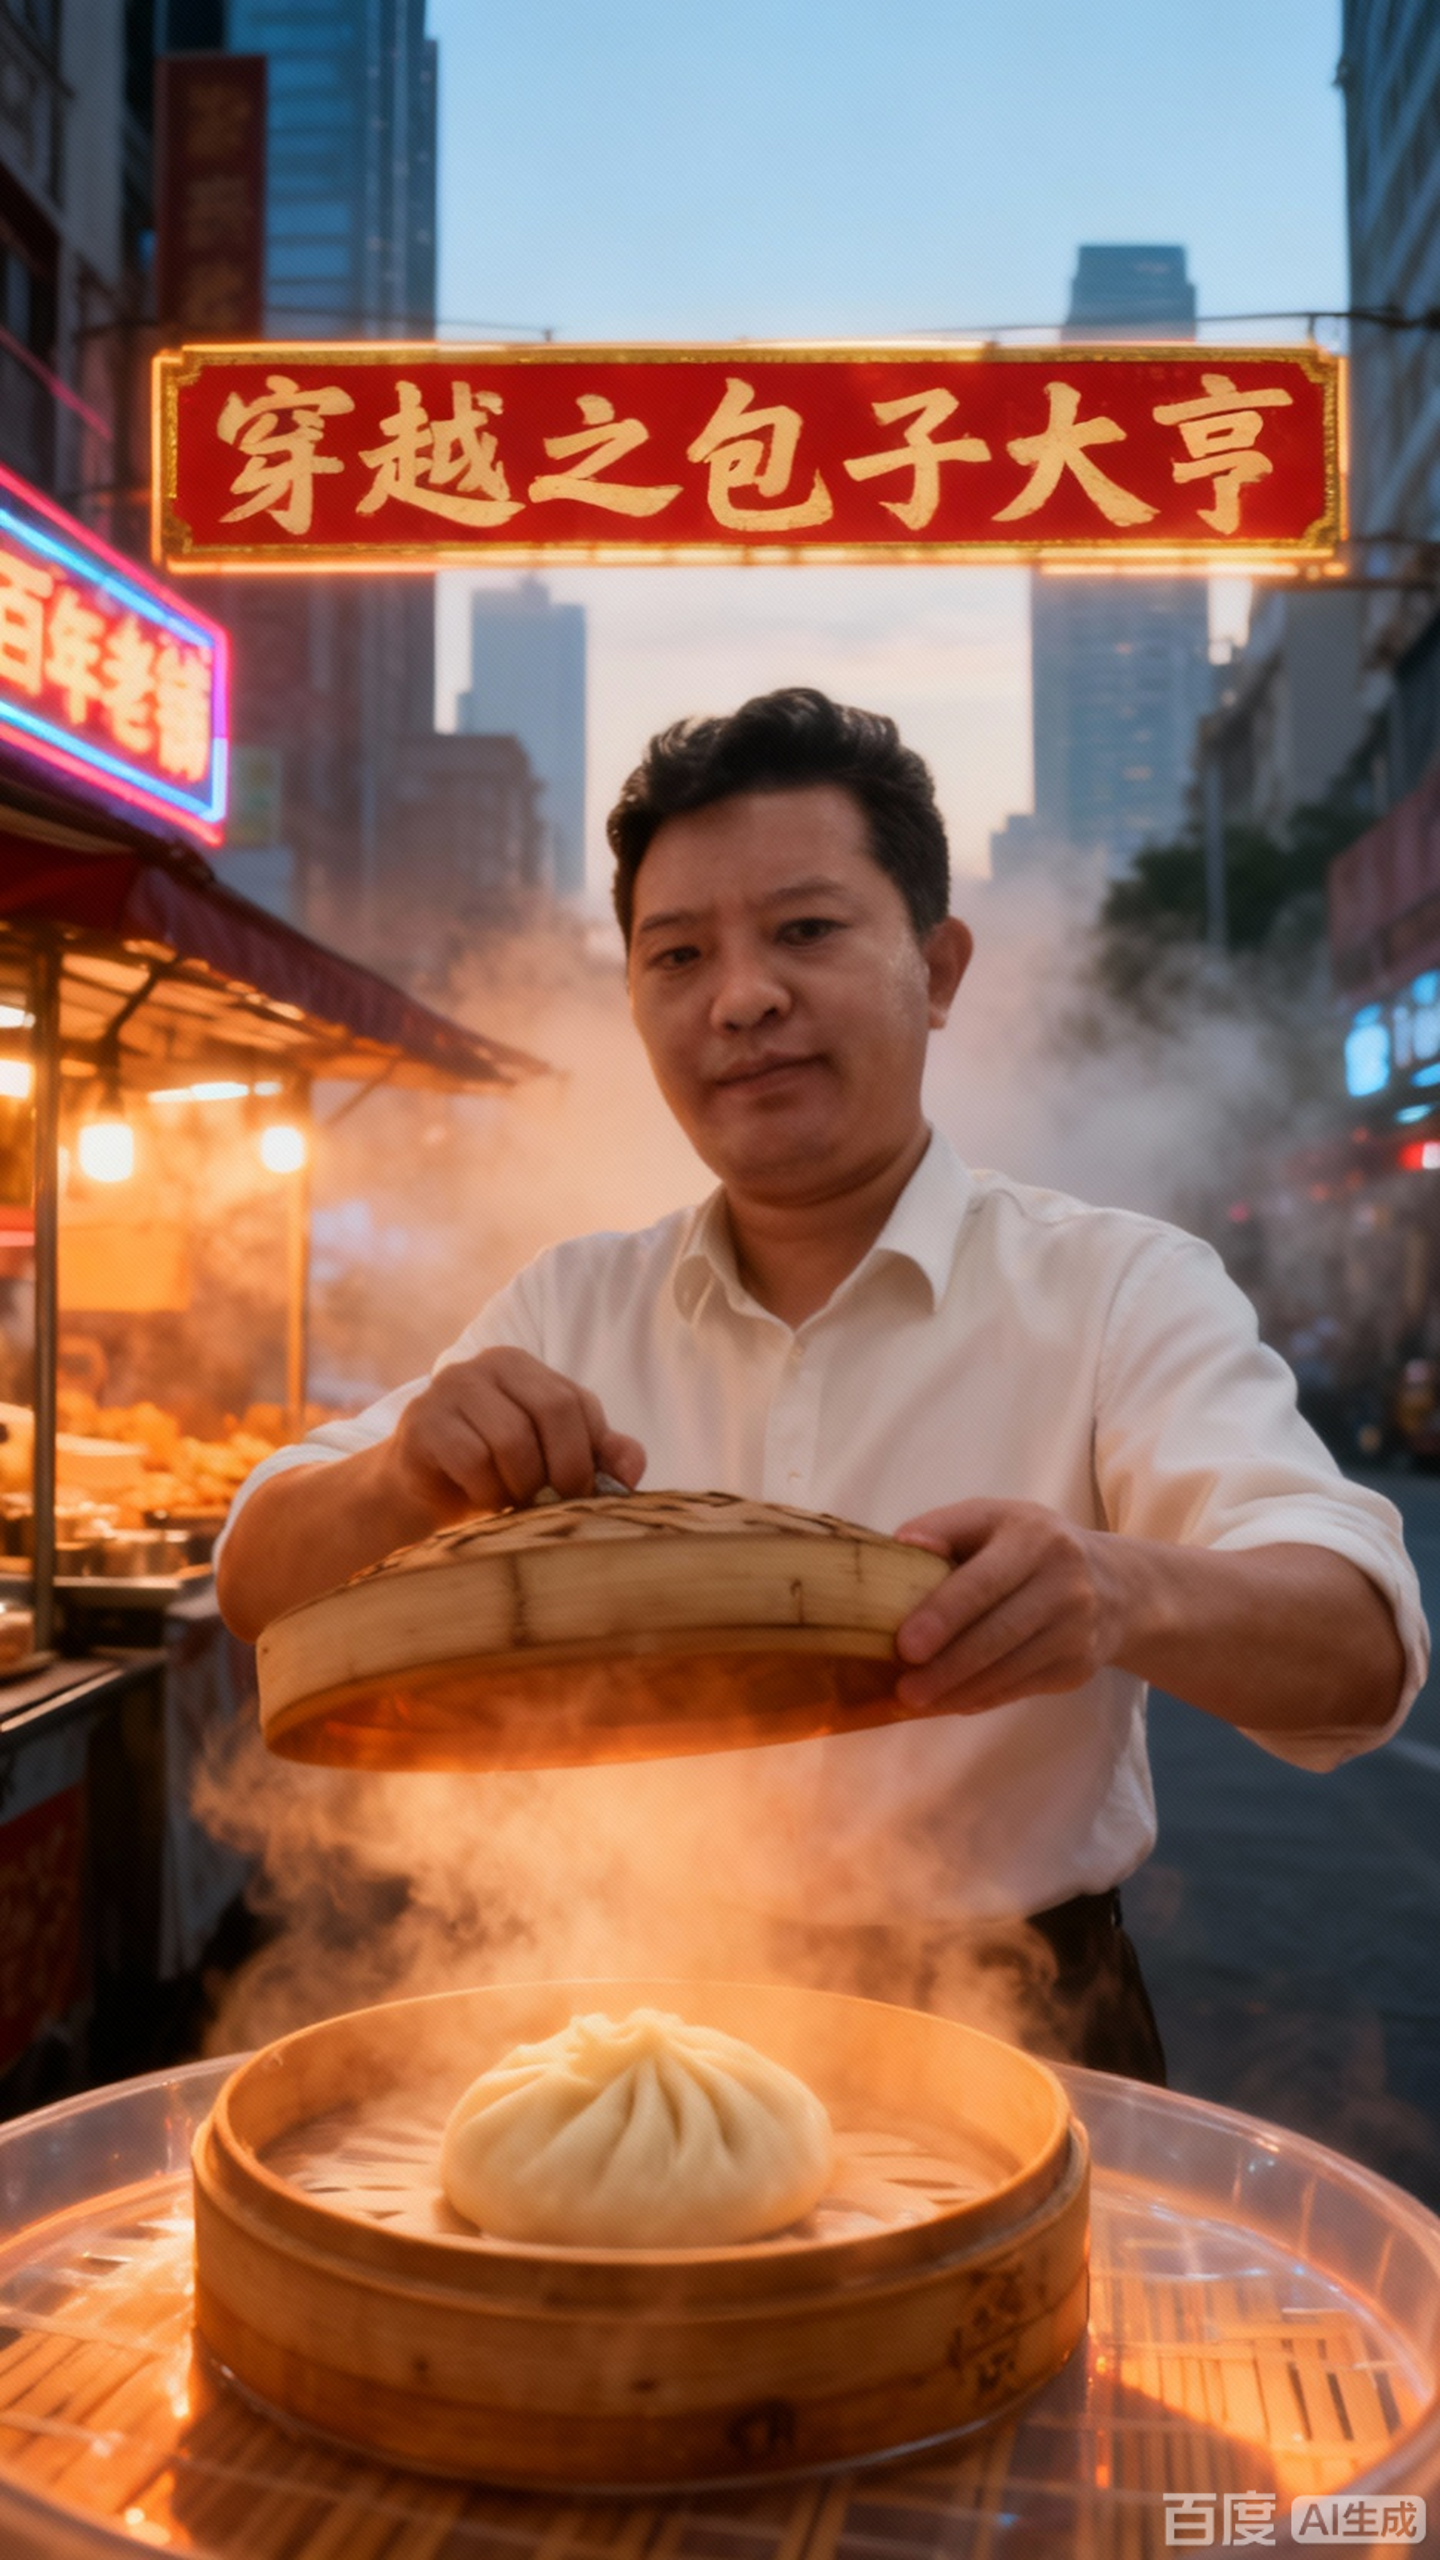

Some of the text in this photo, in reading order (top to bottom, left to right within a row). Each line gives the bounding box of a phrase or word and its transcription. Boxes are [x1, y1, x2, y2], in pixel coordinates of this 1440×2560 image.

[216, 376, 1293, 535] 穿越之包子大亨
